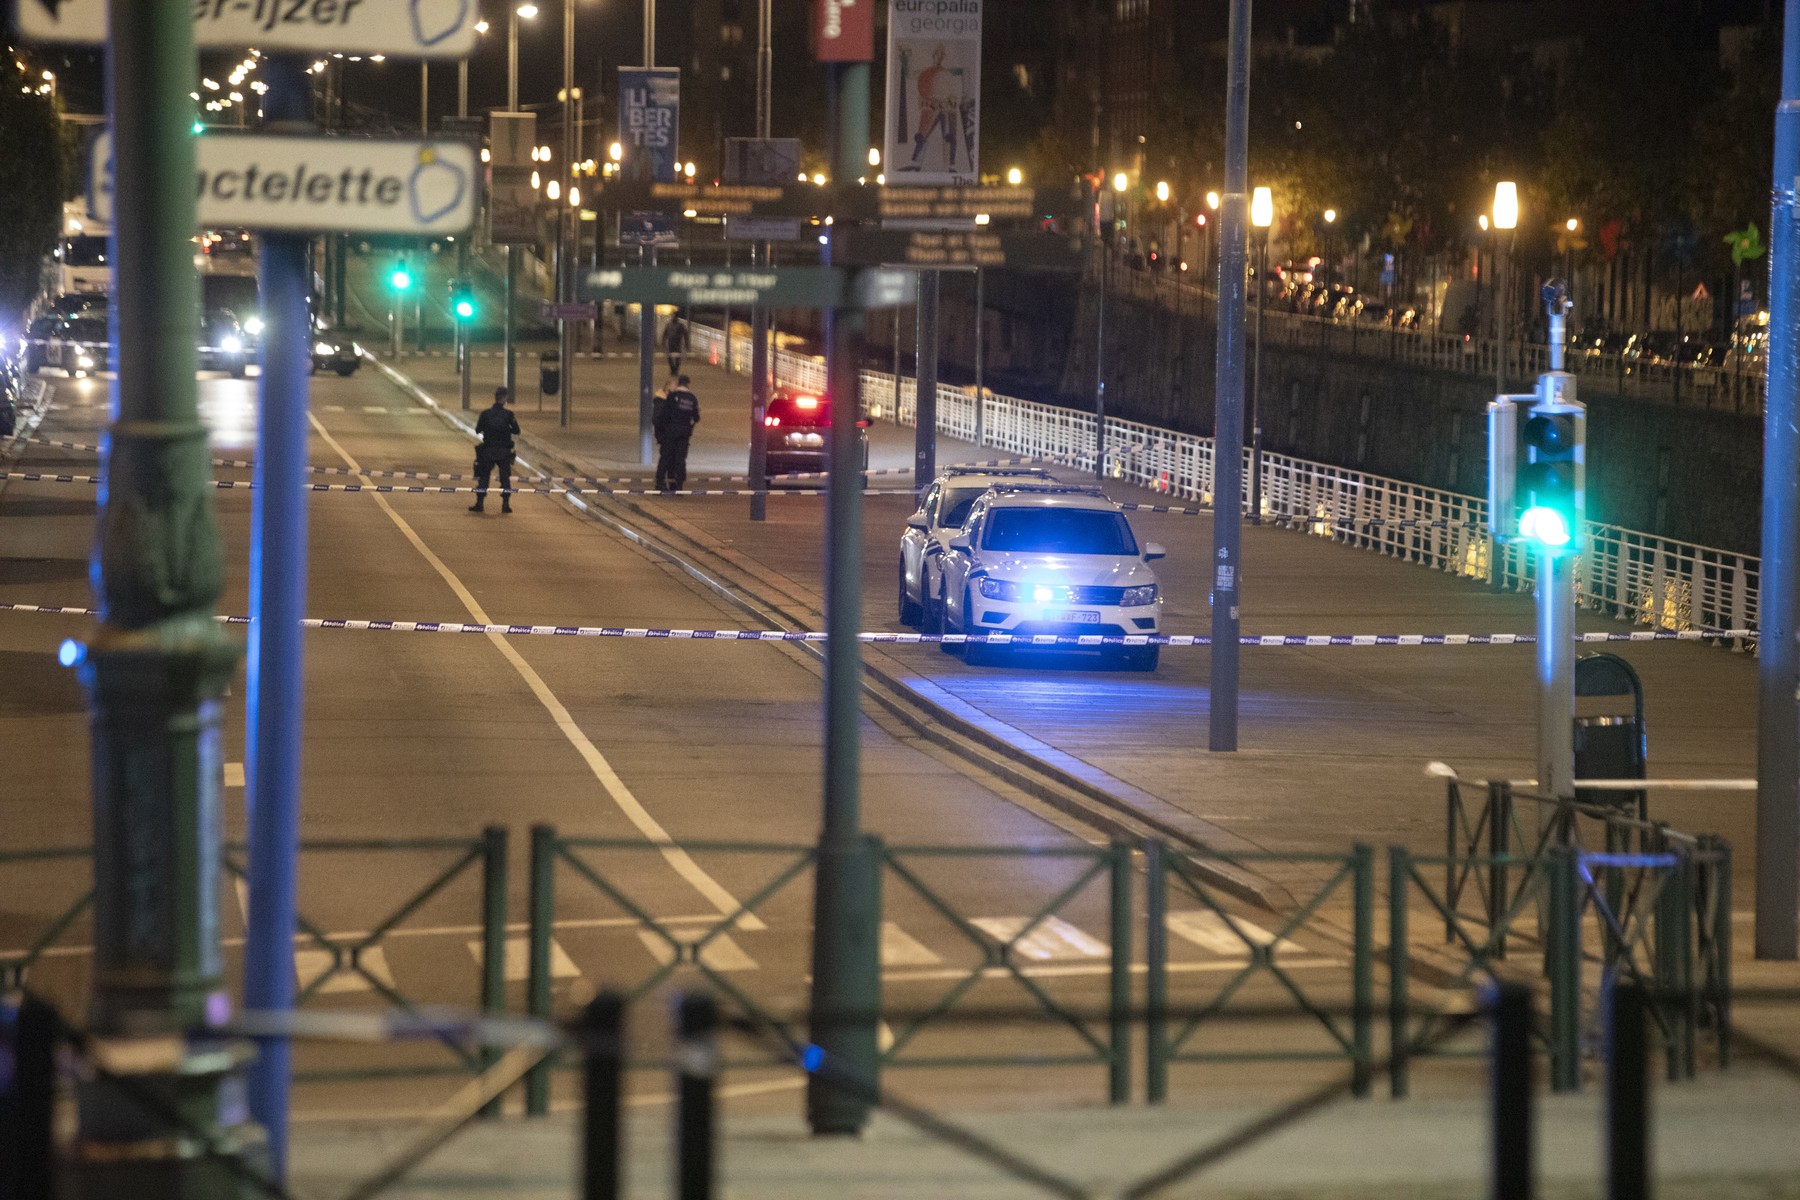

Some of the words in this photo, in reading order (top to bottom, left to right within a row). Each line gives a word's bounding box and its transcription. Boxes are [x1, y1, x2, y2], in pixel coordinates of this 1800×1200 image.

[895, 0, 978, 16] europalia
[910, 17, 978, 34] georgia
[629, 107, 672, 127] BER
[203, 164, 403, 206] ctelette
